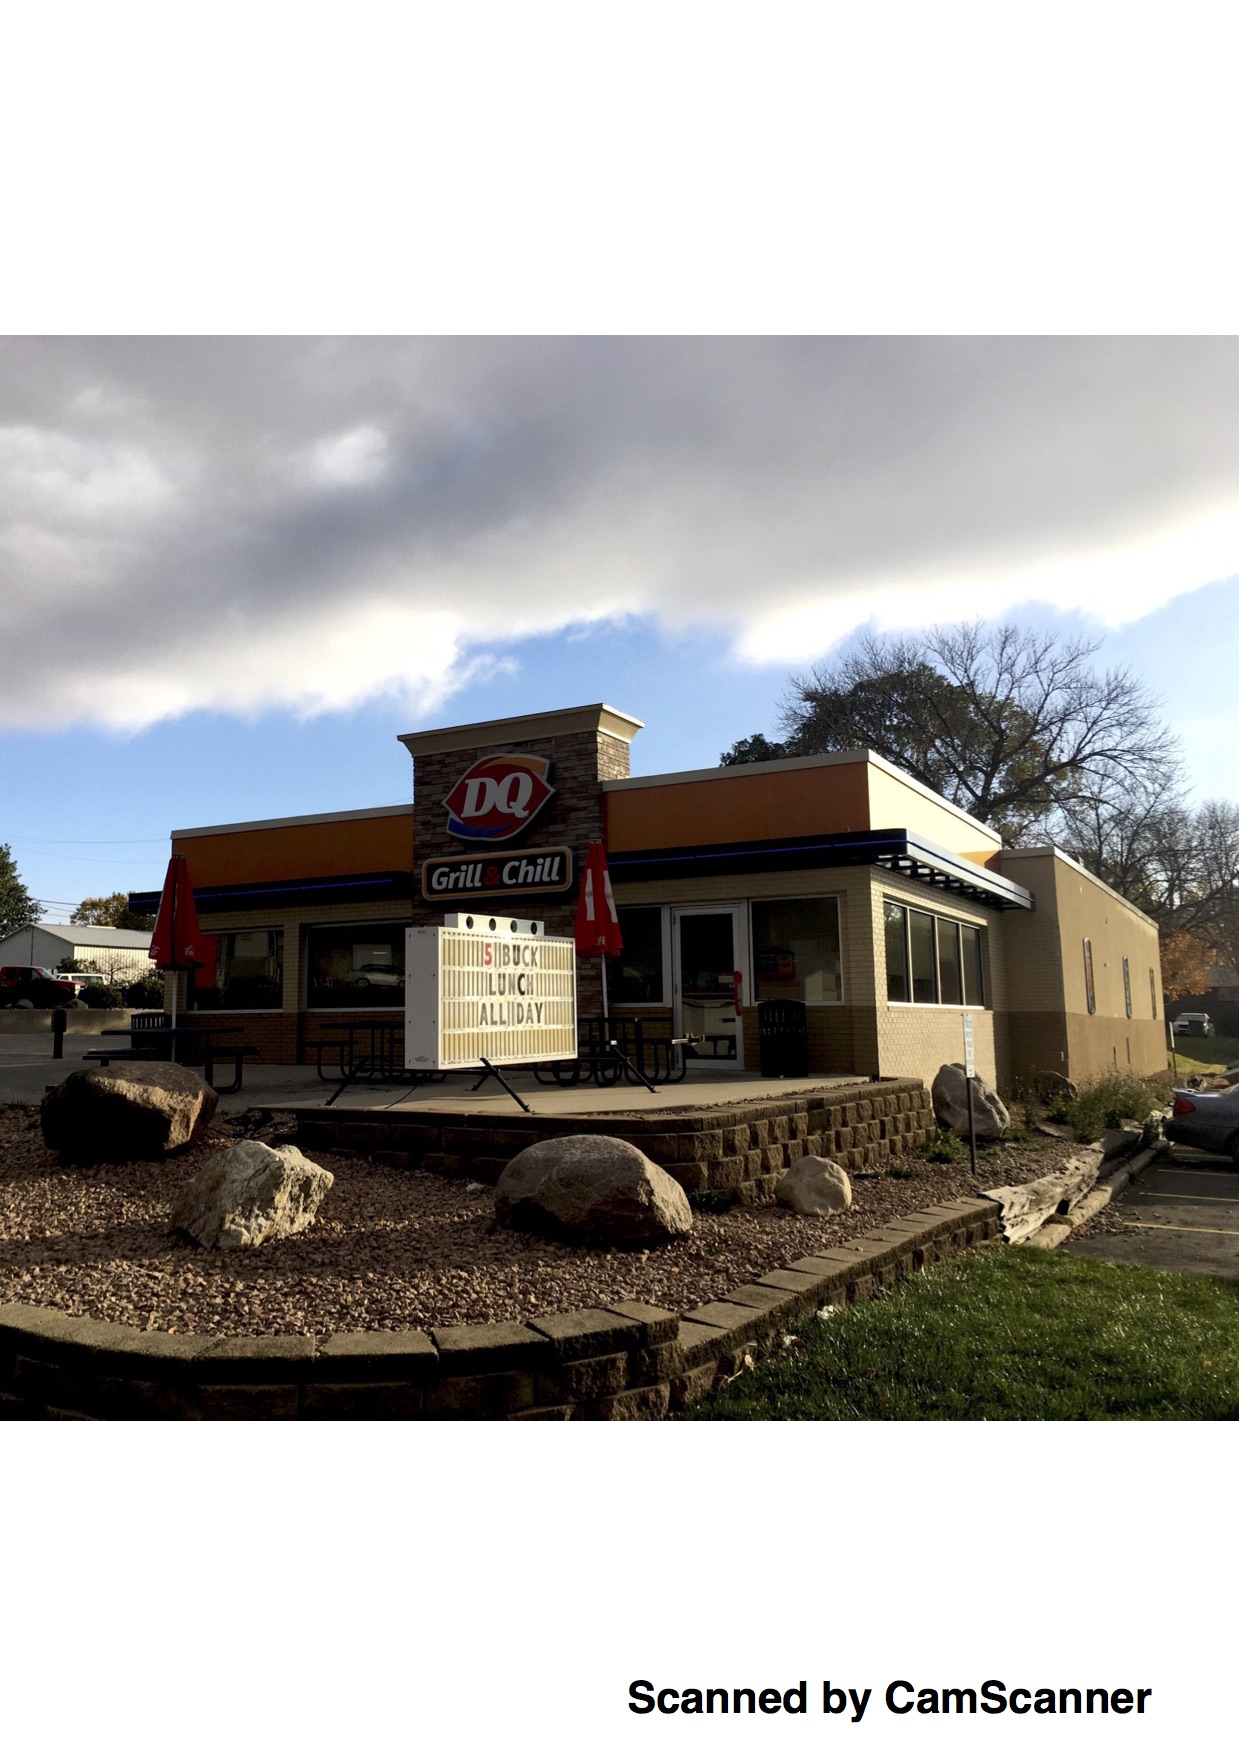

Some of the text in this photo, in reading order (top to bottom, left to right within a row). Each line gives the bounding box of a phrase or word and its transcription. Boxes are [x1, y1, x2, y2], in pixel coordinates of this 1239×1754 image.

[461, 772, 533, 818] DQ
[431, 863, 483, 890] Grill
[502, 856, 561, 885] Chill
[484, 943, 539, 967] 5 BUCK
[488, 972, 534, 996] LUNCH
[480, 1002, 543, 1026] ALL DAY
